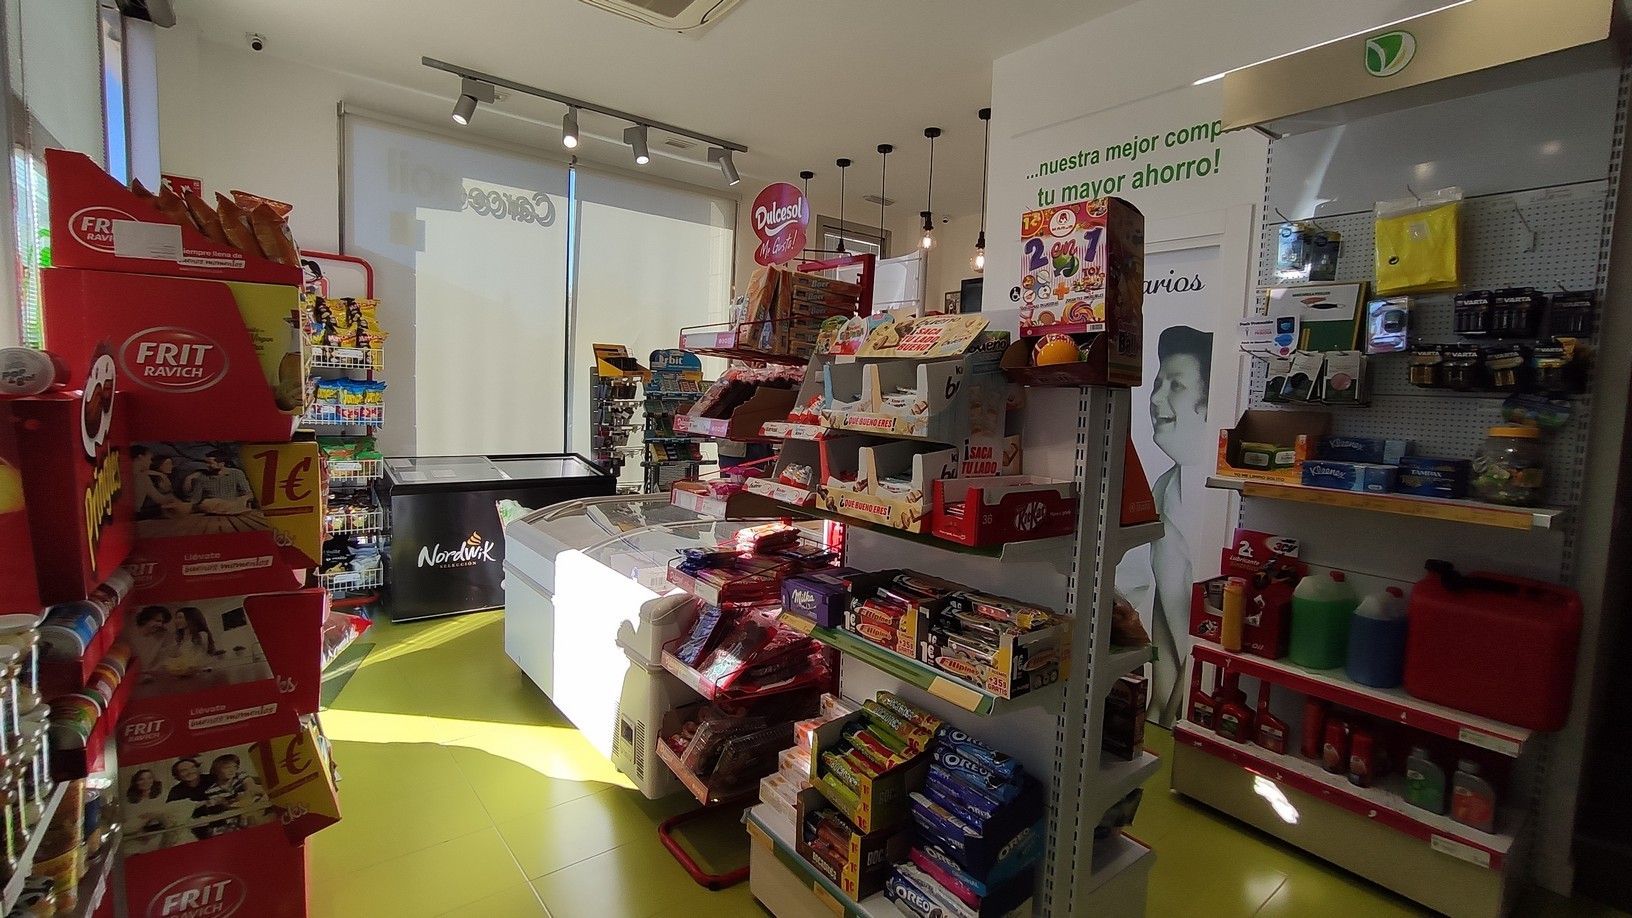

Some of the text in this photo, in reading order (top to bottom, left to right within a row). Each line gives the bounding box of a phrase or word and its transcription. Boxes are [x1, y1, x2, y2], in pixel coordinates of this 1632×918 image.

[1026, 146, 1099, 179] ...nuestra
[1105, 134, 1160, 163] mejor
[1037, 149, 1221, 207] tu mayor ahorro!
[755, 196, 803, 230] Dulcesol
[1024, 227, 1103, 271] 2 en 1
[1082, 266, 1100, 276] TOY
[1504, 296, 1531, 304] VARTA
[902, 335, 941, 343] TU LADO
[136, 342, 214, 368] FRIT
[1494, 351, 1520, 359] VARTA
[144, 366, 204, 379] RAVICH
[1329, 438, 1363, 451] Kleenex
[961, 461, 998, 475] TU LADO
[1309, 465, 1347, 479] Kleenex
[253, 448, 313, 507] 1€
[855, 500, 874, 513] BUENO
[1274, 541, 1298, 553] 3CV
[792, 588, 815, 604] Milka
[920, 640, 935, 664] 1€
[940, 657, 980, 676] Filipinos
[987, 683, 1009, 697] GRATIS
[989, 676, 1008, 689] +35g
[124, 719, 166, 736] FRIT
[248, 735, 314, 795] 1€
[161, 879, 233, 917] FRIT
[895, 883, 932, 914] OREO
